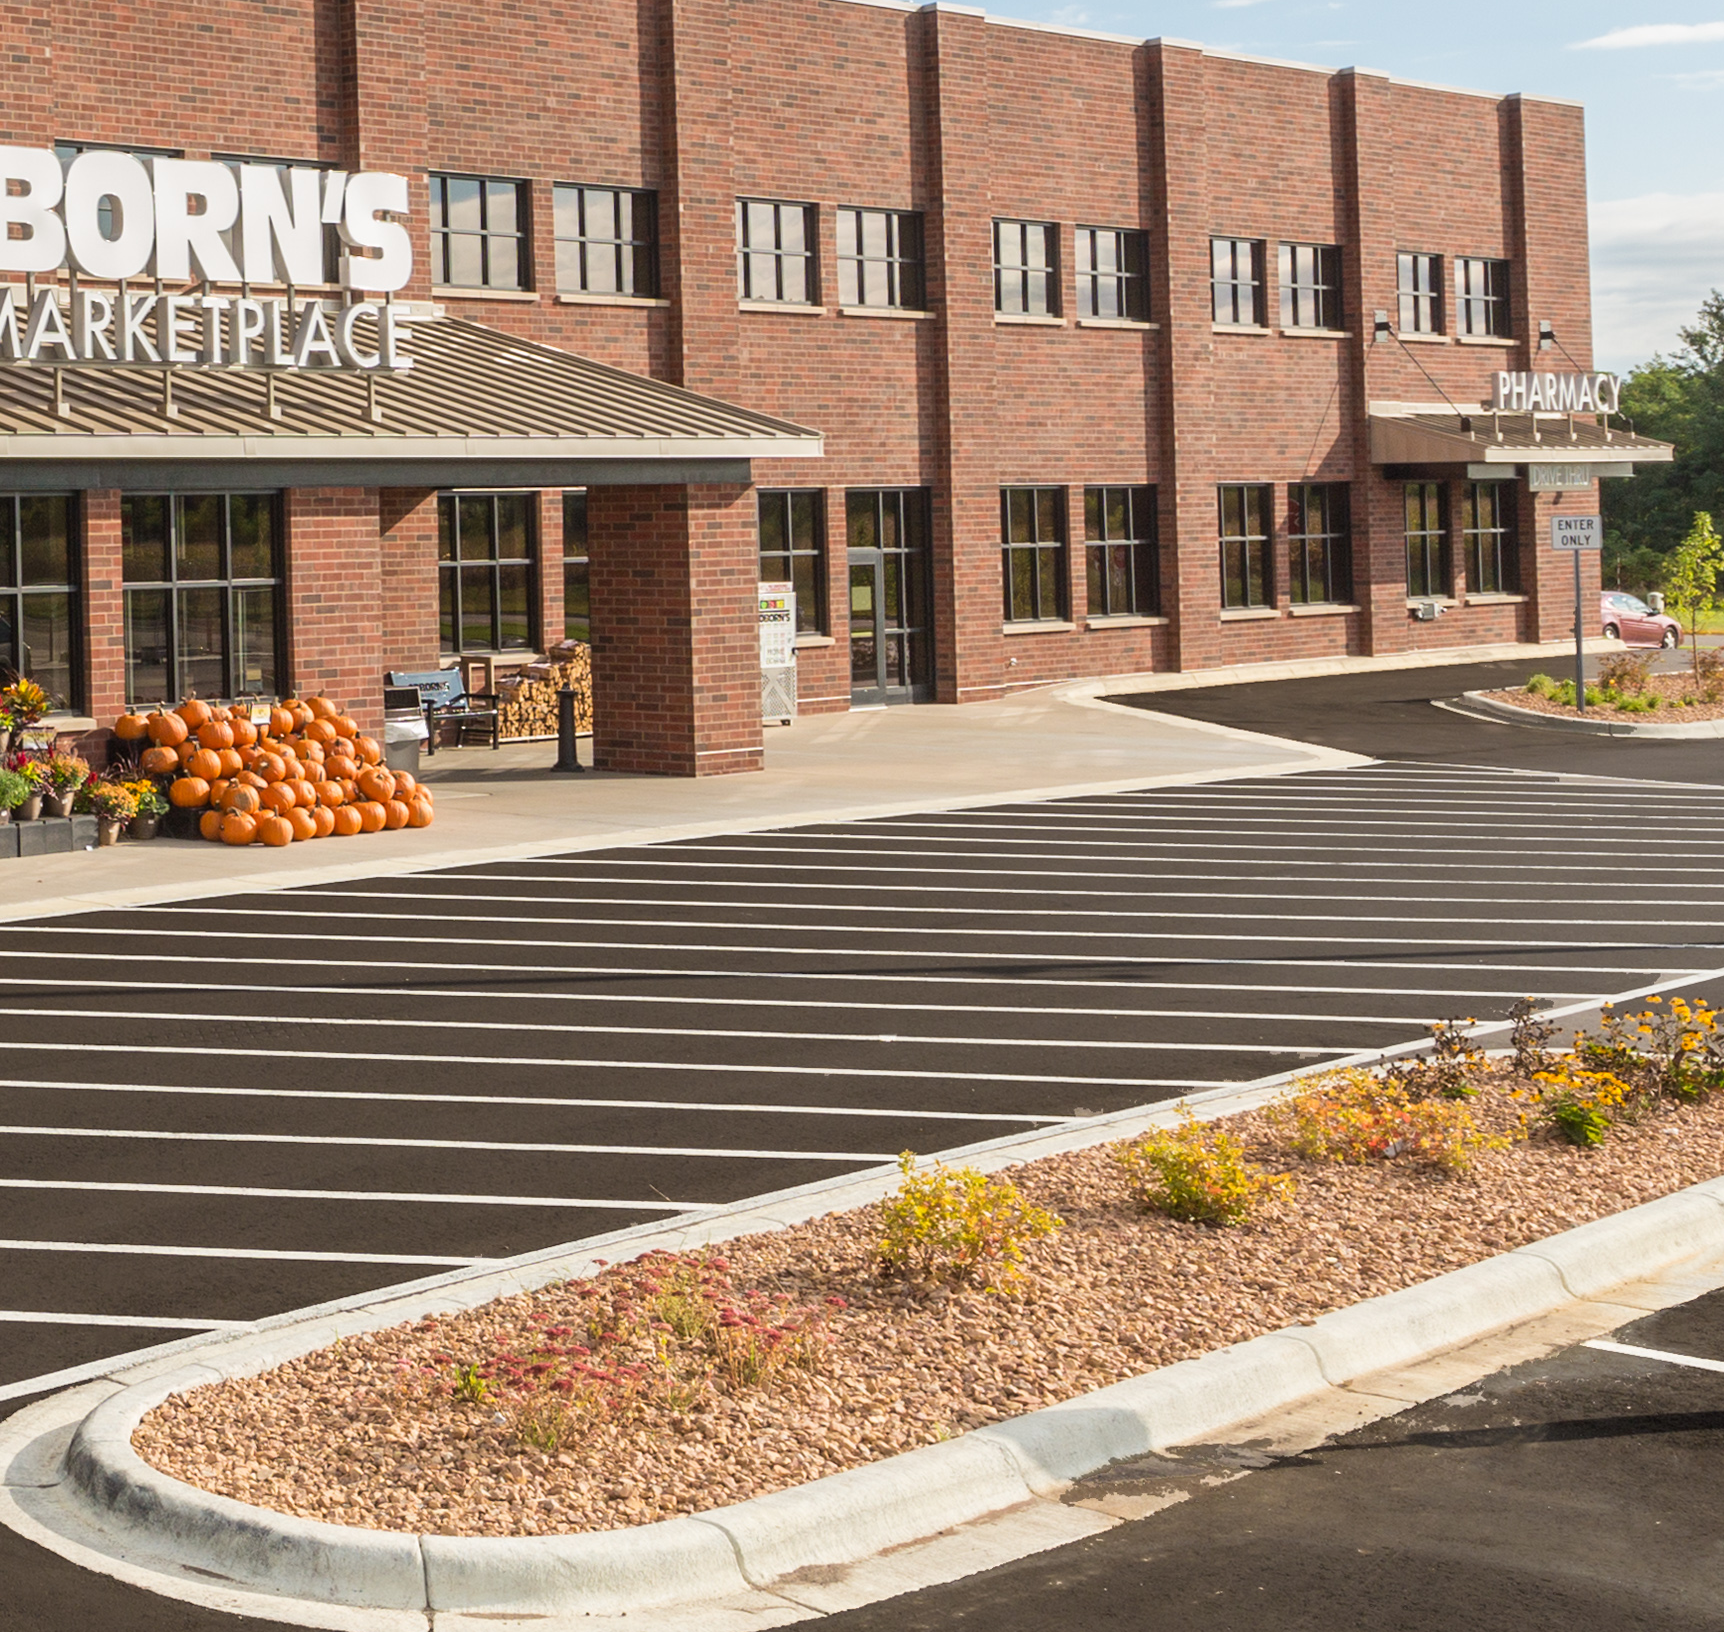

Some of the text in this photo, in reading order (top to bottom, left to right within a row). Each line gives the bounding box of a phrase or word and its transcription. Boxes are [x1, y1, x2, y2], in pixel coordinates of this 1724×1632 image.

[1497, 371, 1622, 412] PHARMACY
[1533, 465, 1590, 486] DRIVE THRU
[1557, 519, 1594, 531] ENTER
[1561, 534, 1591, 547] ONLY
[759, 612, 791, 623] OBORN'S
